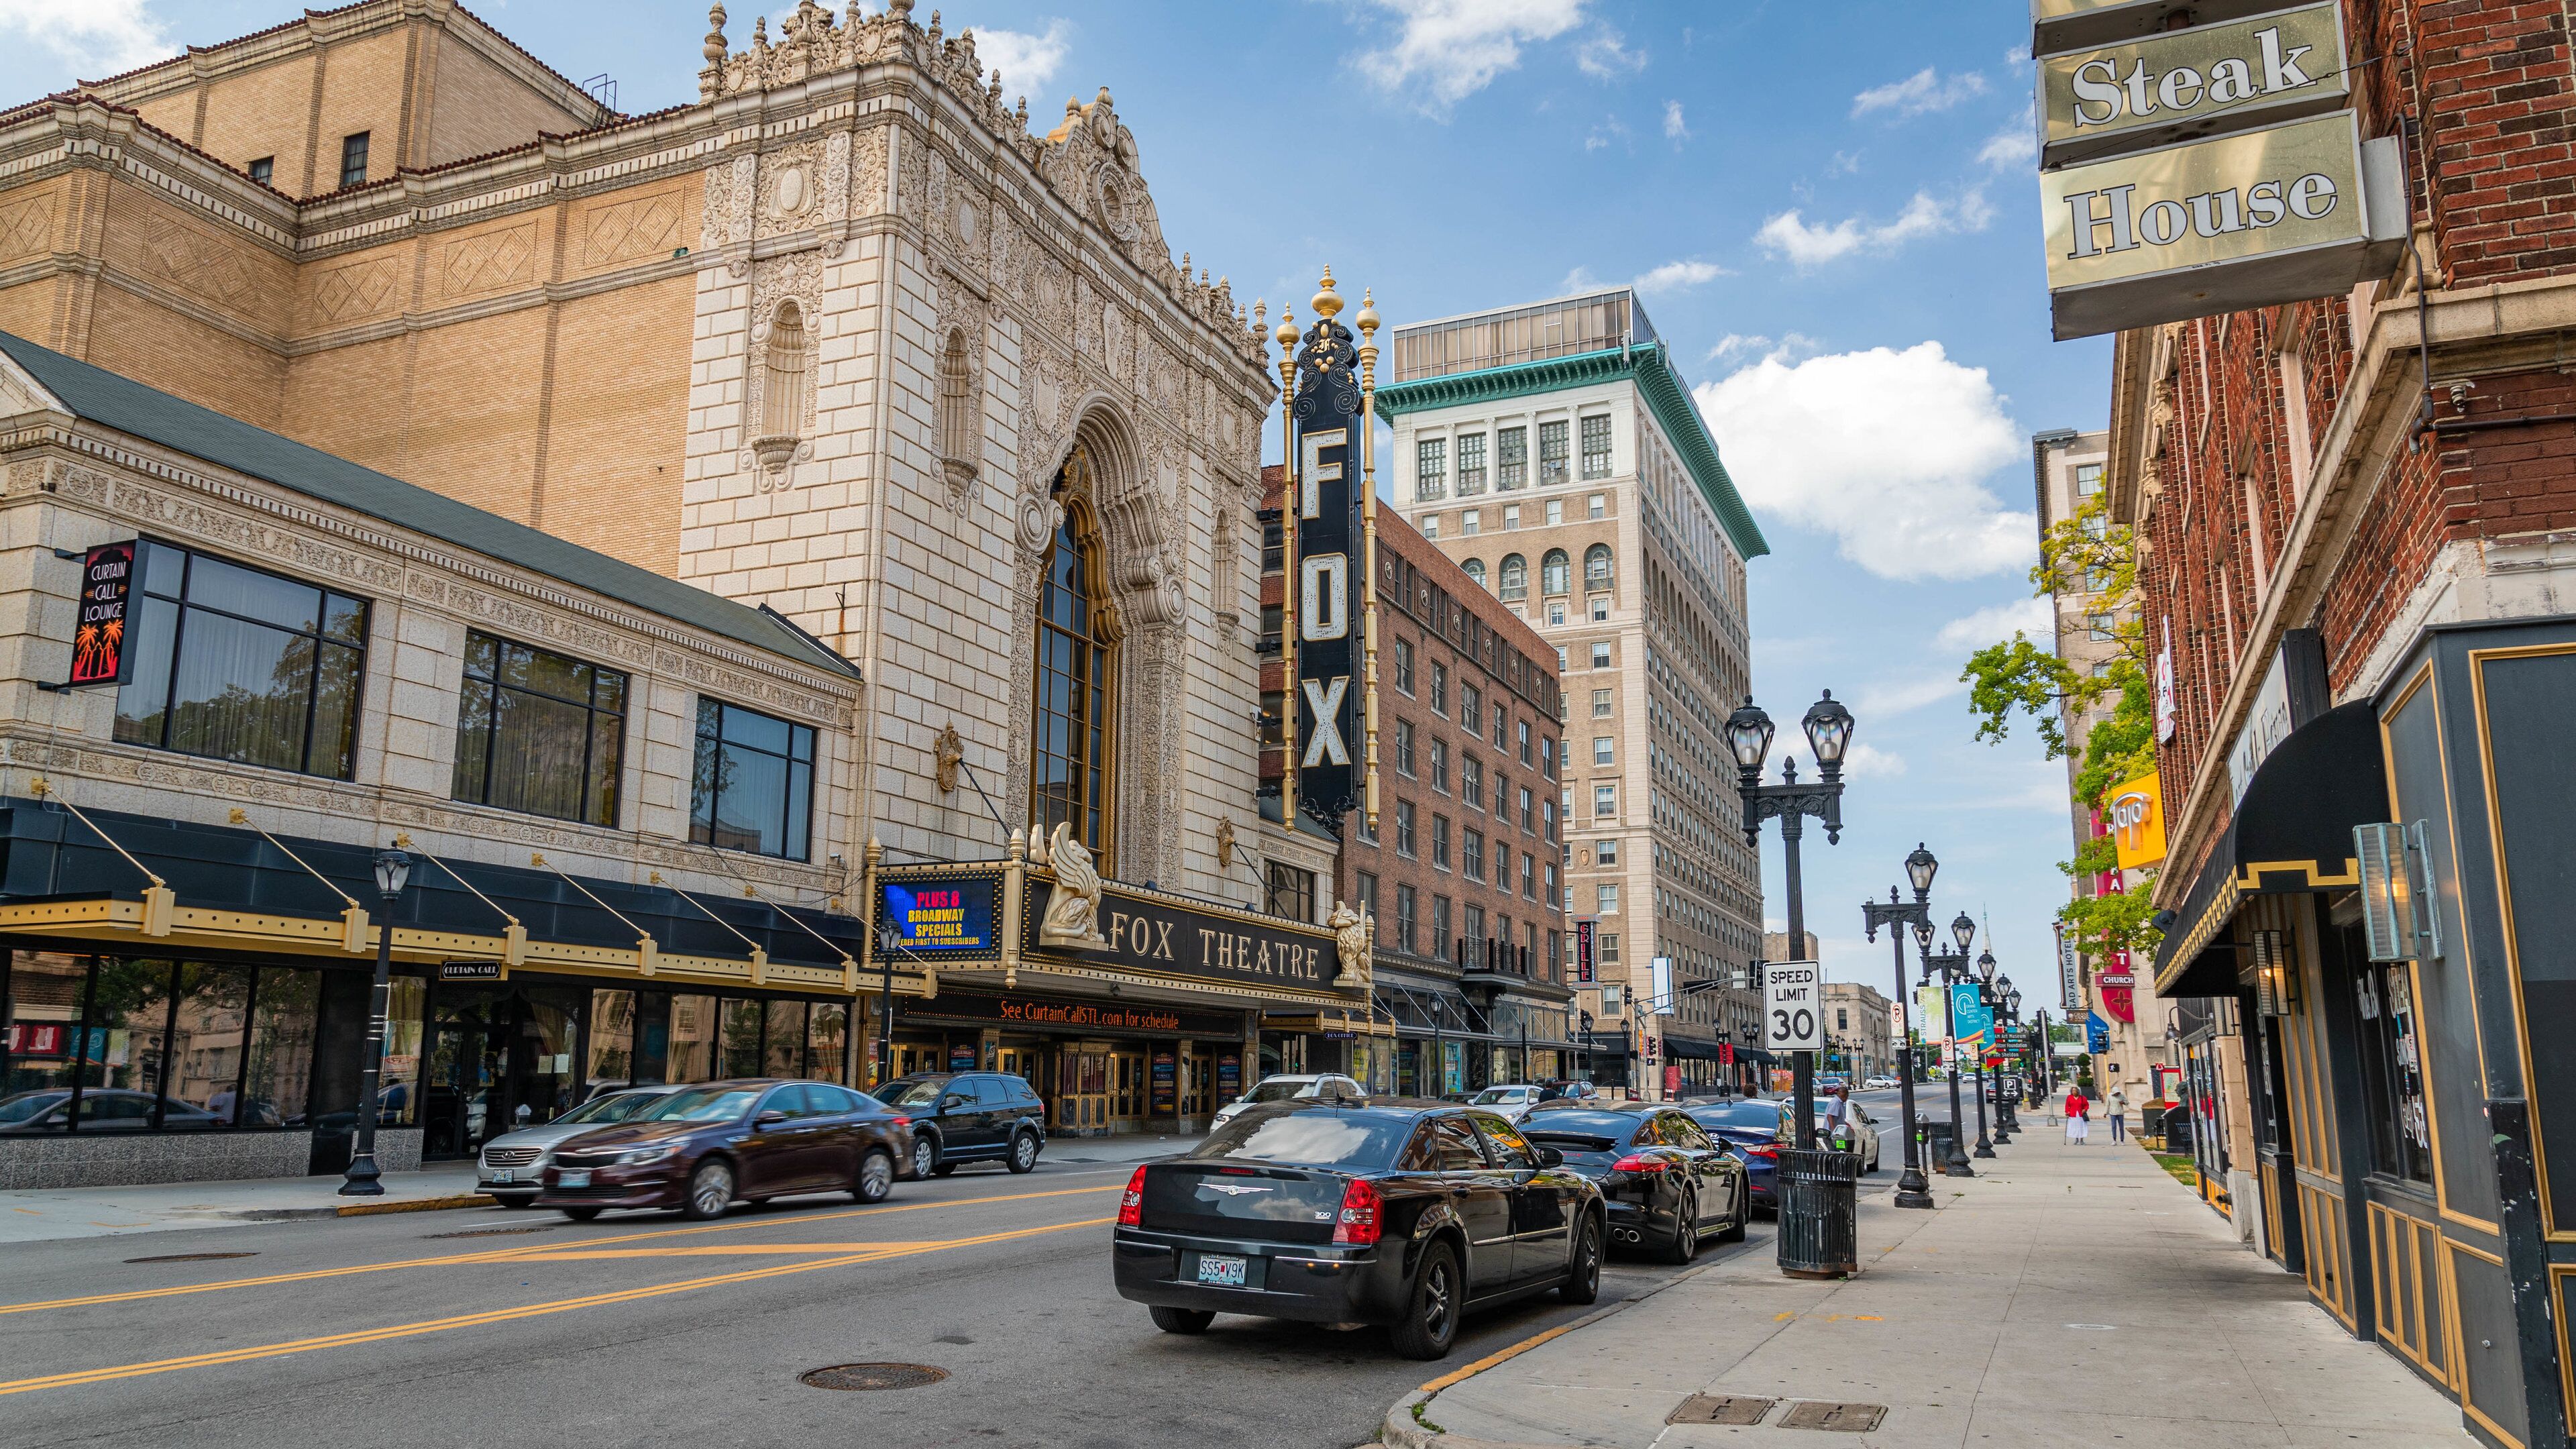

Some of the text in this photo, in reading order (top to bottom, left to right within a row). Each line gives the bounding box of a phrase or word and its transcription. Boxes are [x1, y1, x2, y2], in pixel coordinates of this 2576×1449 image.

[2072, 27, 2318, 128] Steak
[2063, 172, 2338, 260] House
[91, 561, 126, 581] CURTAIN
[95, 583, 117, 600] CALL
[1301, 427, 1350, 767] FOX
[85, 602, 123, 622] LOUNGE
[917, 891, 959, 908] PLUS 8
[908, 909, 965, 922] BROADWAY
[916, 923, 962, 936] SPECIALS
[900, 938, 914, 947] ERED
[915, 938, 930, 946] FIRST
[1109, 911, 1320, 981] FOX THEATRE
[1580, 924, 1589, 980] GRILLE
[2065, 939, 2073, 965] HOTEL
[1770, 970, 1813, 984] SPEED
[2067, 968, 2075, 989] ARTS
[2103, 976, 2134, 984] CHURCH
[1776, 988, 1808, 1002] LIMIT
[1001, 1001, 1179, 1030] See CurtainCallSTL.com for schedule
[1772, 1008, 1814, 1041] 30
[1201, 1260, 1244, 1279] SS5 V9K
